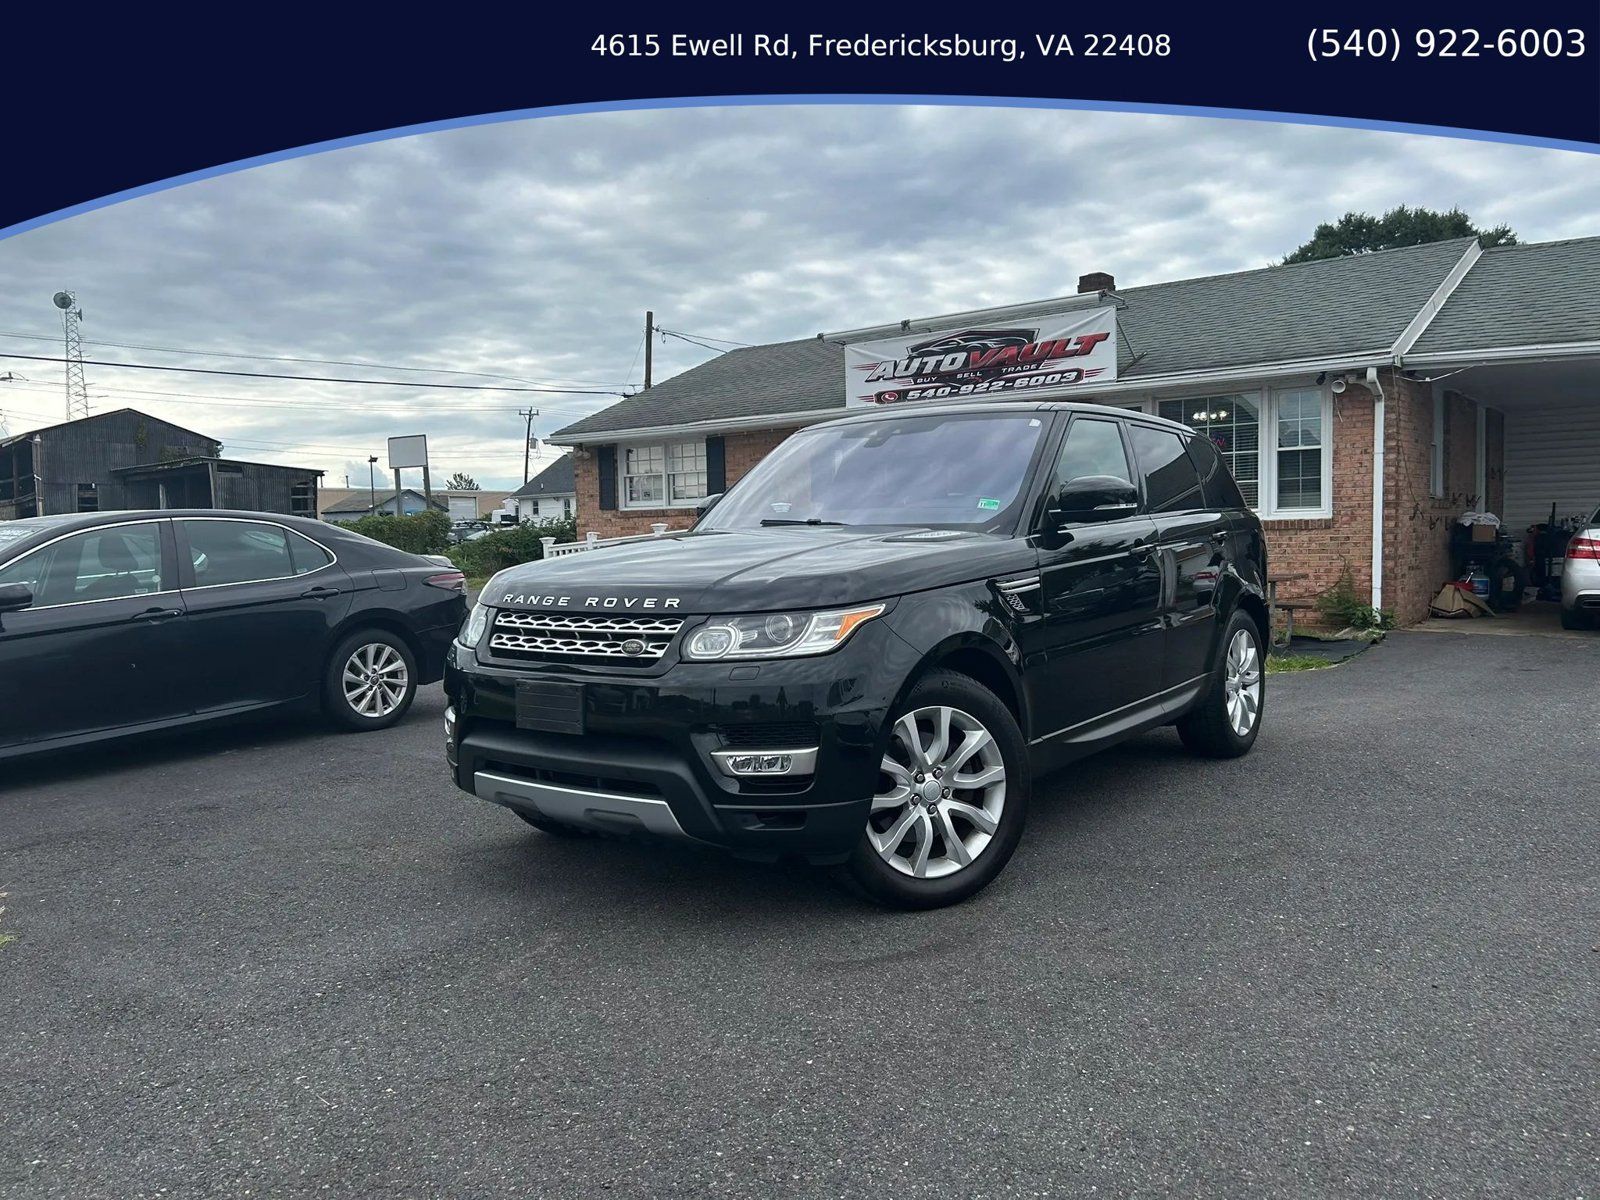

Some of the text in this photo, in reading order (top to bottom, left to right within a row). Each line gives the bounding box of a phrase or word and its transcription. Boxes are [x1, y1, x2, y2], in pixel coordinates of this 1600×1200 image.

[916, 363, 1038, 384] BUY SELL TRADE
[906, 371, 1079, 400] 540-922-6003
[502, 593, 681, 608] RANGE ROVER
